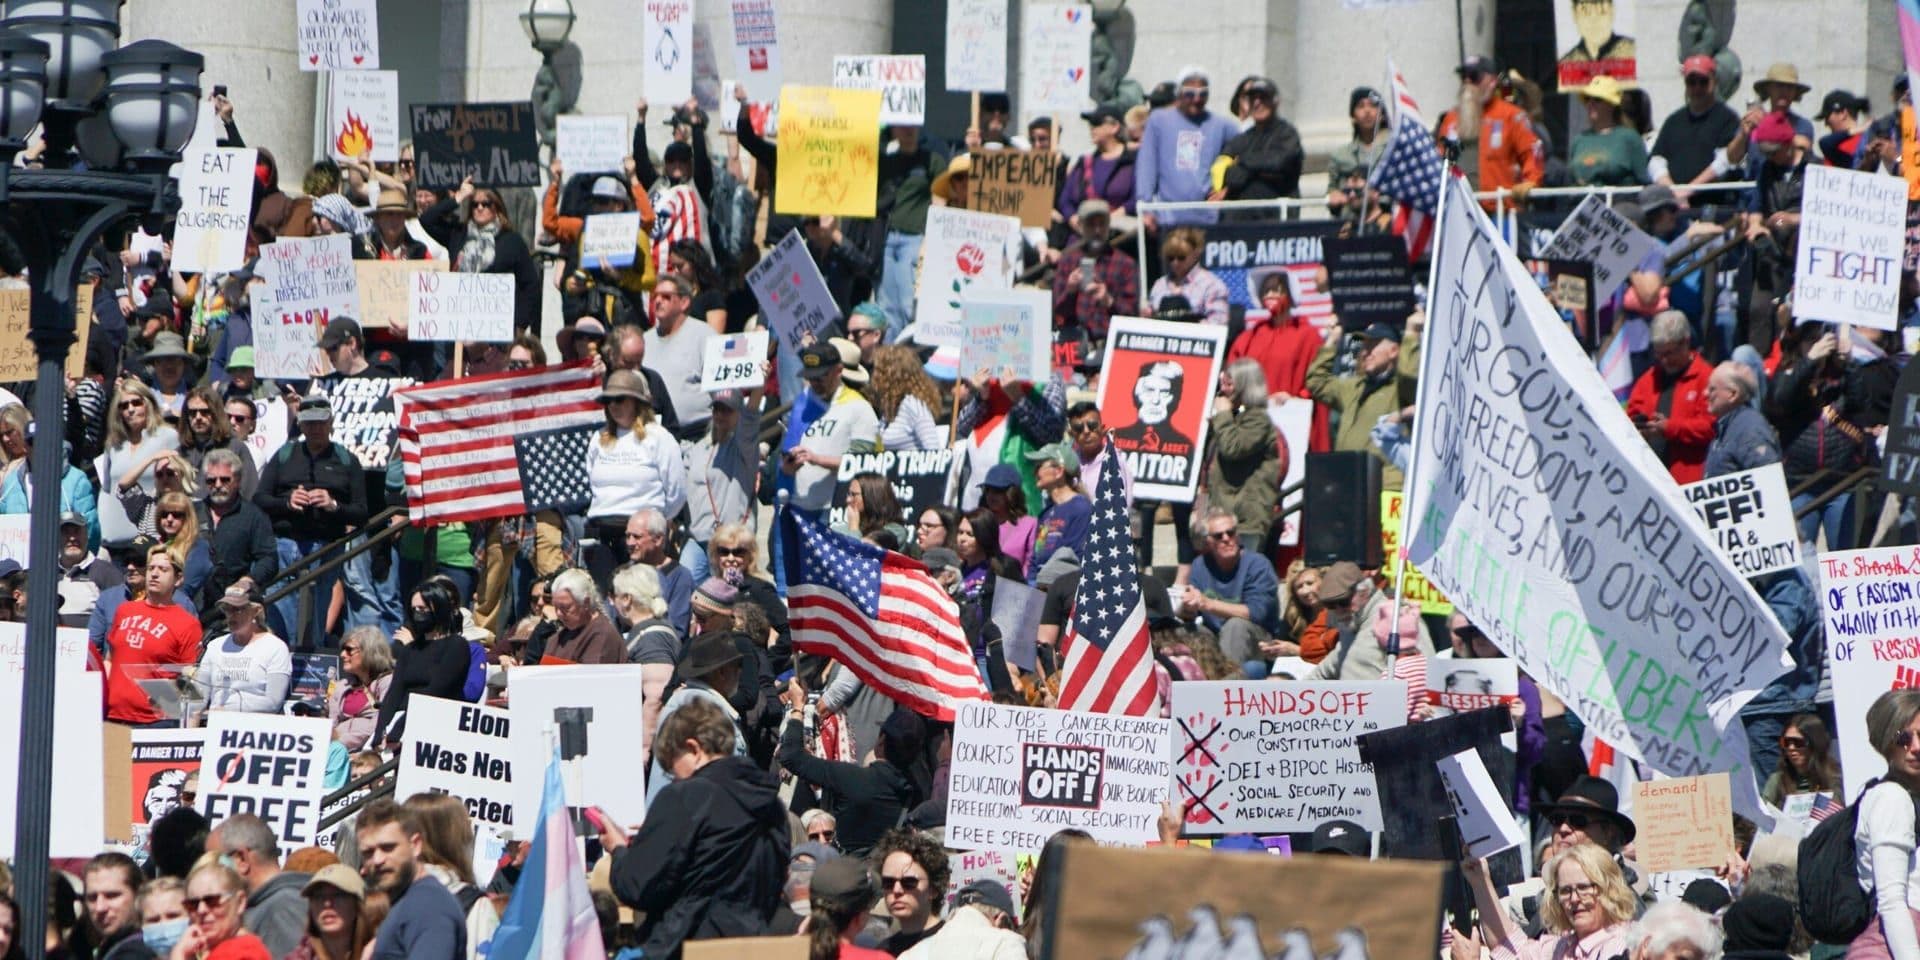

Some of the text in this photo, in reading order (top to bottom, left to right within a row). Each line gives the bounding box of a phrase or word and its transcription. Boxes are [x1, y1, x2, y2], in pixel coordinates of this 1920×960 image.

[341, 27, 367, 41] AND
[835, 59, 925, 81] MAKE NAZIS
[201, 153, 235, 174] EAT
[969, 152, 1057, 186] IMPEACH
[198, 186, 231, 207] THE
[1811, 168, 1904, 207] The future
[177, 211, 247, 231] OLIGARCHS
[1601, 209, 1632, 236] ONLY
[1805, 196, 1899, 228] demands
[1609, 238, 1630, 255] TO
[1806, 219, 1888, 251] that we
[267, 238, 330, 261] POWER TO
[277, 251, 343, 274] THE PEOPLE
[323, 265, 351, 281] MUSK
[1808, 247, 1896, 286] FIGHT
[275, 279, 357, 303] IMPEACH TRUMP
[418, 272, 511, 295] NO KINGS
[1799, 277, 1898, 311] for it NOW
[418, 298, 440, 315] NO
[418, 319, 510, 340] NO NAZIS
[788, 304, 826, 347] ACTION
[920, 321, 962, 337] RESISTAN
[1118, 334, 1212, 355] A DANGER TO US ALL
[332, 411, 398, 429] LUSION
[361, 427, 391, 446] US
[1162, 442, 1190, 455] ASSET
[838, 449, 953, 482] DUMP TRUMP
[1464, 393, 1594, 524] FREEDOM,
[891, 480, 914, 500] his
[1695, 491, 1766, 531] FF!
[1527, 514, 1596, 585] AND
[1747, 530, 1759, 545] &
[1729, 539, 1796, 574] ECURITY
[1820, 558, 1849, 579] The
[1456, 527, 1532, 641] TITLE
[1548, 610, 1605, 678] OF
[1828, 586, 1849, 612] OF
[119, 614, 169, 640] UTAH
[1431, 556, 1475, 616] ALMA
[1545, 660, 1572, 700] NO
[1884, 607, 1903, 629] in
[1835, 639, 1856, 662] OF
[1223, 686, 1373, 717] HANDS OFF
[1439, 692, 1502, 710] RESIST
[458, 705, 511, 739] Elon
[960, 703, 1170, 736] OUR JOBS CANCER RESEARCH
[1258, 718, 1355, 738] DEMOCRACY
[1362, 720, 1378, 730] AND
[132, 745, 198, 760] A DANGER TO US
[219, 729, 315, 754] HANDS
[956, 741, 1015, 766] COURTS
[1016, 728, 1157, 755] THE CONSTITUTION
[1256, 738, 1352, 755] CONSTITUTION
[415, 740, 468, 775] Was
[1025, 746, 1101, 775] HANDS
[1105, 754, 1170, 778] IMMIGRANTS
[216, 751, 312, 789] OFF!
[1228, 758, 1375, 782] DEI BIPOC HISTOR
[952, 774, 1168, 805] EDUCATION OUR BODIES
[1236, 783, 1372, 802] SOCIAL SECURITY AND
[1639, 776, 1698, 798] demand
[204, 793, 311, 843] FREE
[950, 798, 978, 816] FREE
[1031, 808, 1079, 827] SOCIAL
[1082, 809, 1152, 832] SECURITY
[952, 825, 996, 846] FREE
[962, 850, 1003, 871] HOME
